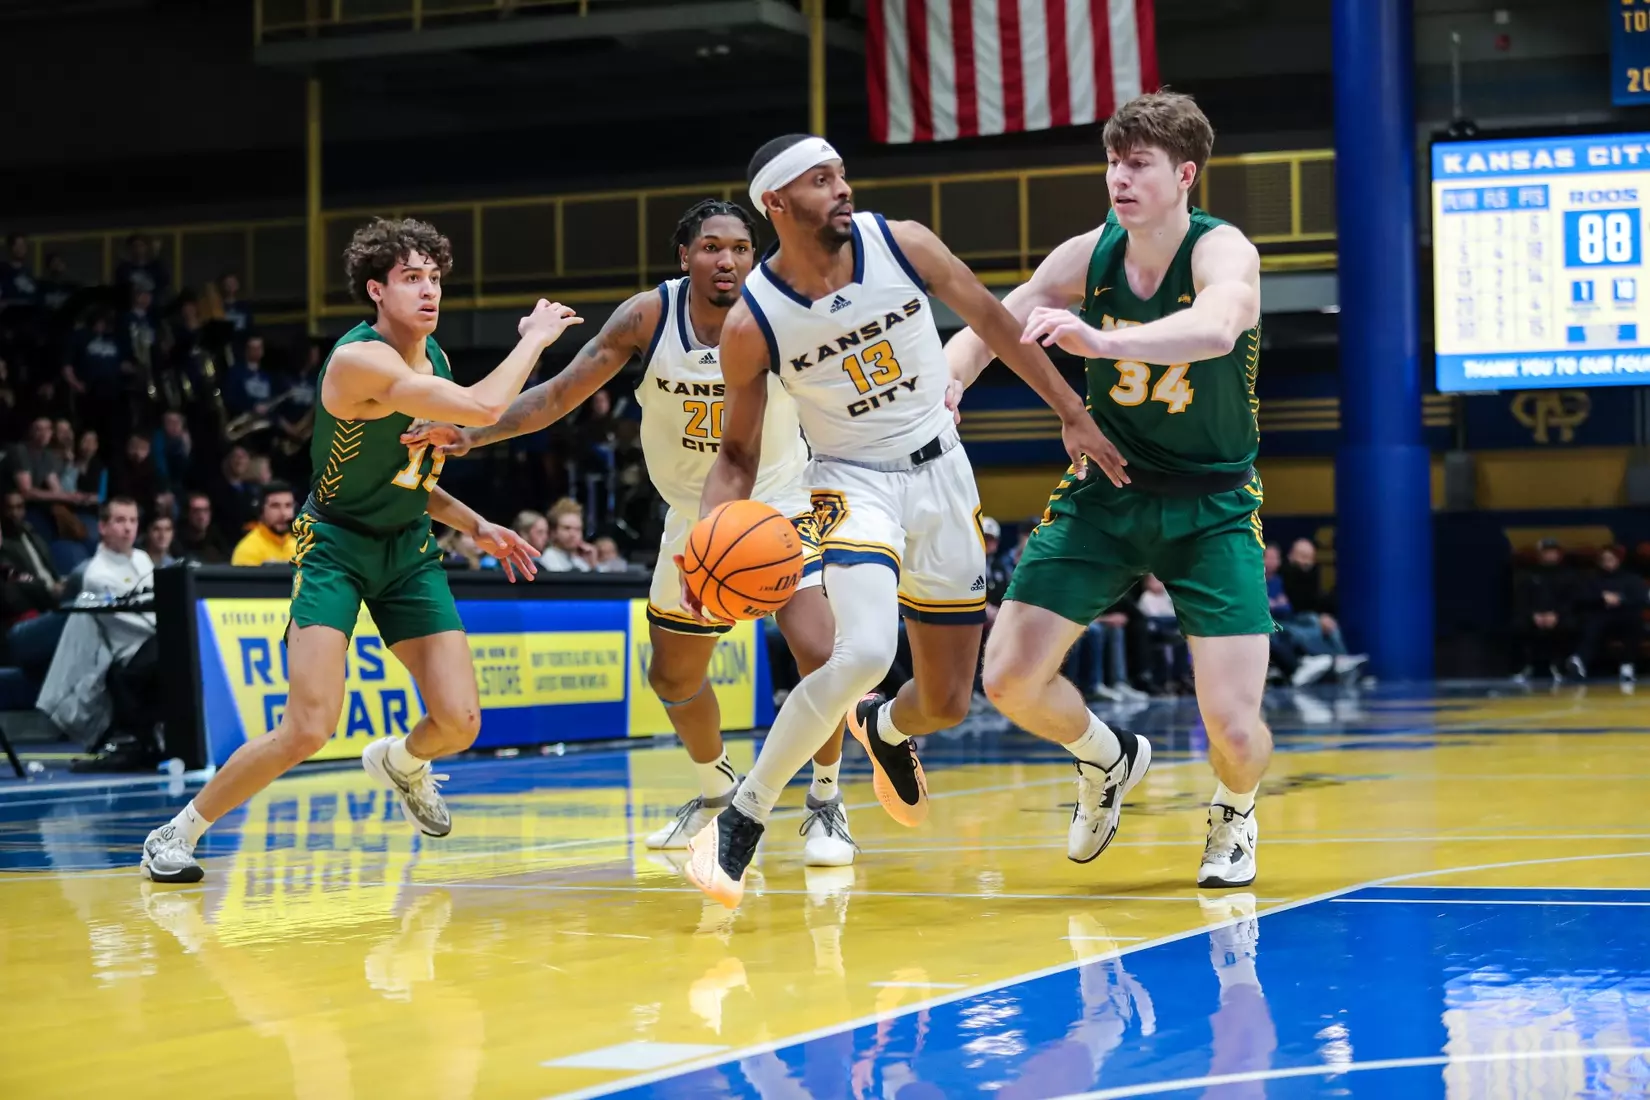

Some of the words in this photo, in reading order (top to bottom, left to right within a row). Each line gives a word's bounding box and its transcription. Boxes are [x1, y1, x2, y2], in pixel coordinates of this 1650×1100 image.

[1621, 10, 1650, 32] TO
[1442, 147, 1575, 174] KANSAS
[1570, 189, 1637, 203] ROOS
[1578, 212, 1632, 264] 88
[830, 300, 852, 313] adidas
[790, 297, 922, 372] KANSAS
[842, 339, 902, 395] 13
[1108, 360, 1194, 414] 34
[1521, 357, 1553, 376] YOU
[1556, 356, 1578, 375] TO
[847, 375, 919, 418] CITY
[683, 400, 723, 438] 20
[237, 636, 386, 686] RS
[263, 689, 410, 738] GAR
